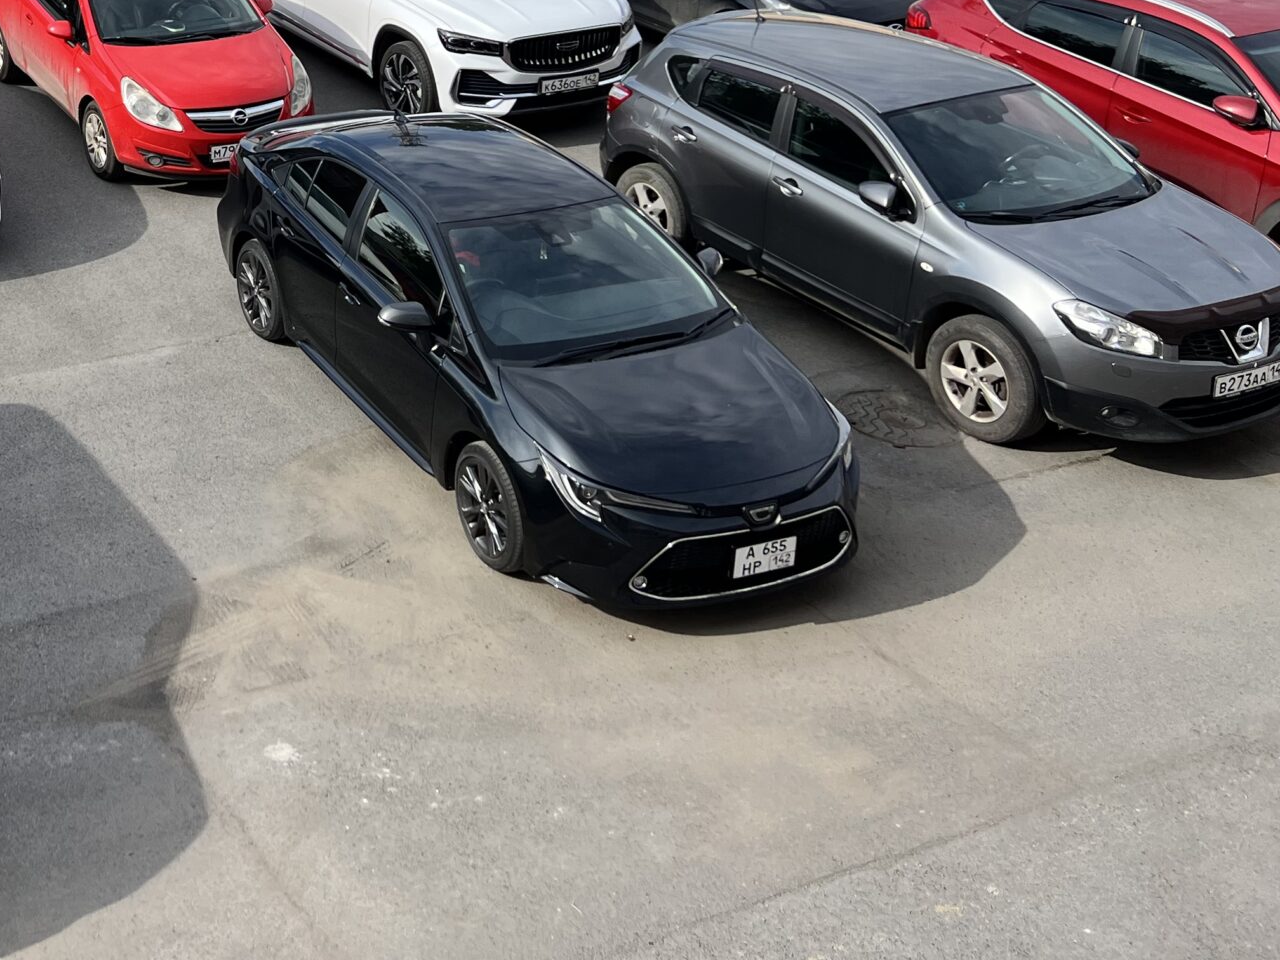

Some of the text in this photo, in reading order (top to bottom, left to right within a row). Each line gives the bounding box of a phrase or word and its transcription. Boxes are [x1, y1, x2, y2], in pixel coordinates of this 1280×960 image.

[544, 74, 597, 92] К636ОЕ 142
[1219, 371, 1267, 395] В273АА
[746, 539, 788, 560] А 655
[742, 553, 791, 576] НР 142
